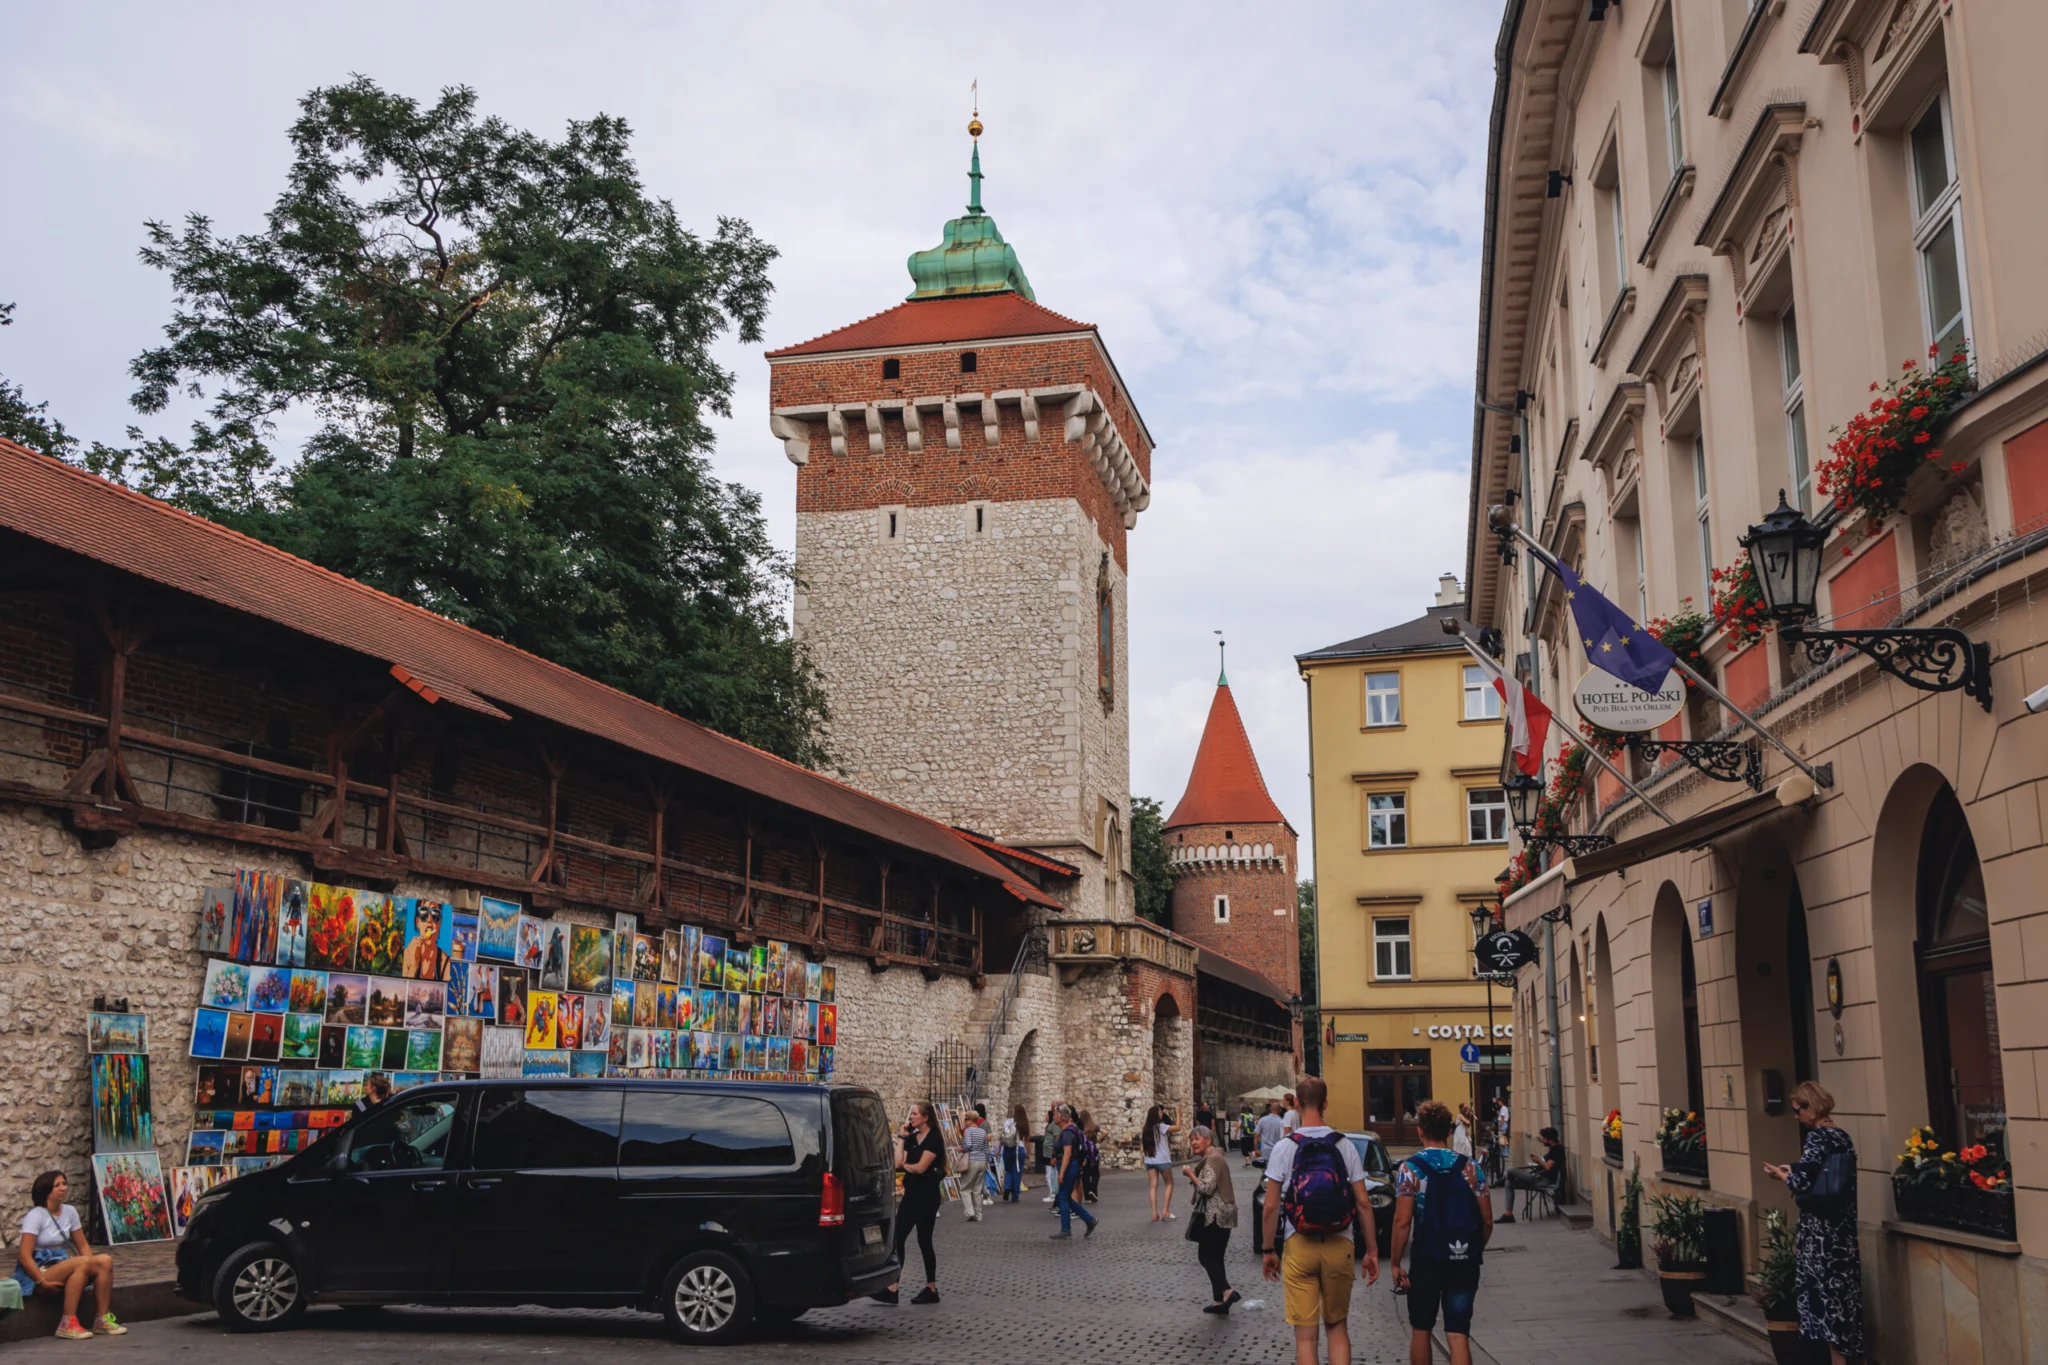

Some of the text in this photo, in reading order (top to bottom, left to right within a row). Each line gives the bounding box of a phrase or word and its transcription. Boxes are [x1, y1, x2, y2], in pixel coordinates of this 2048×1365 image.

[1768, 552, 1790, 580] 17
[1581, 690, 1681, 705] HOTEL POLSKI
[1427, 1024, 1485, 1040] COSTA
